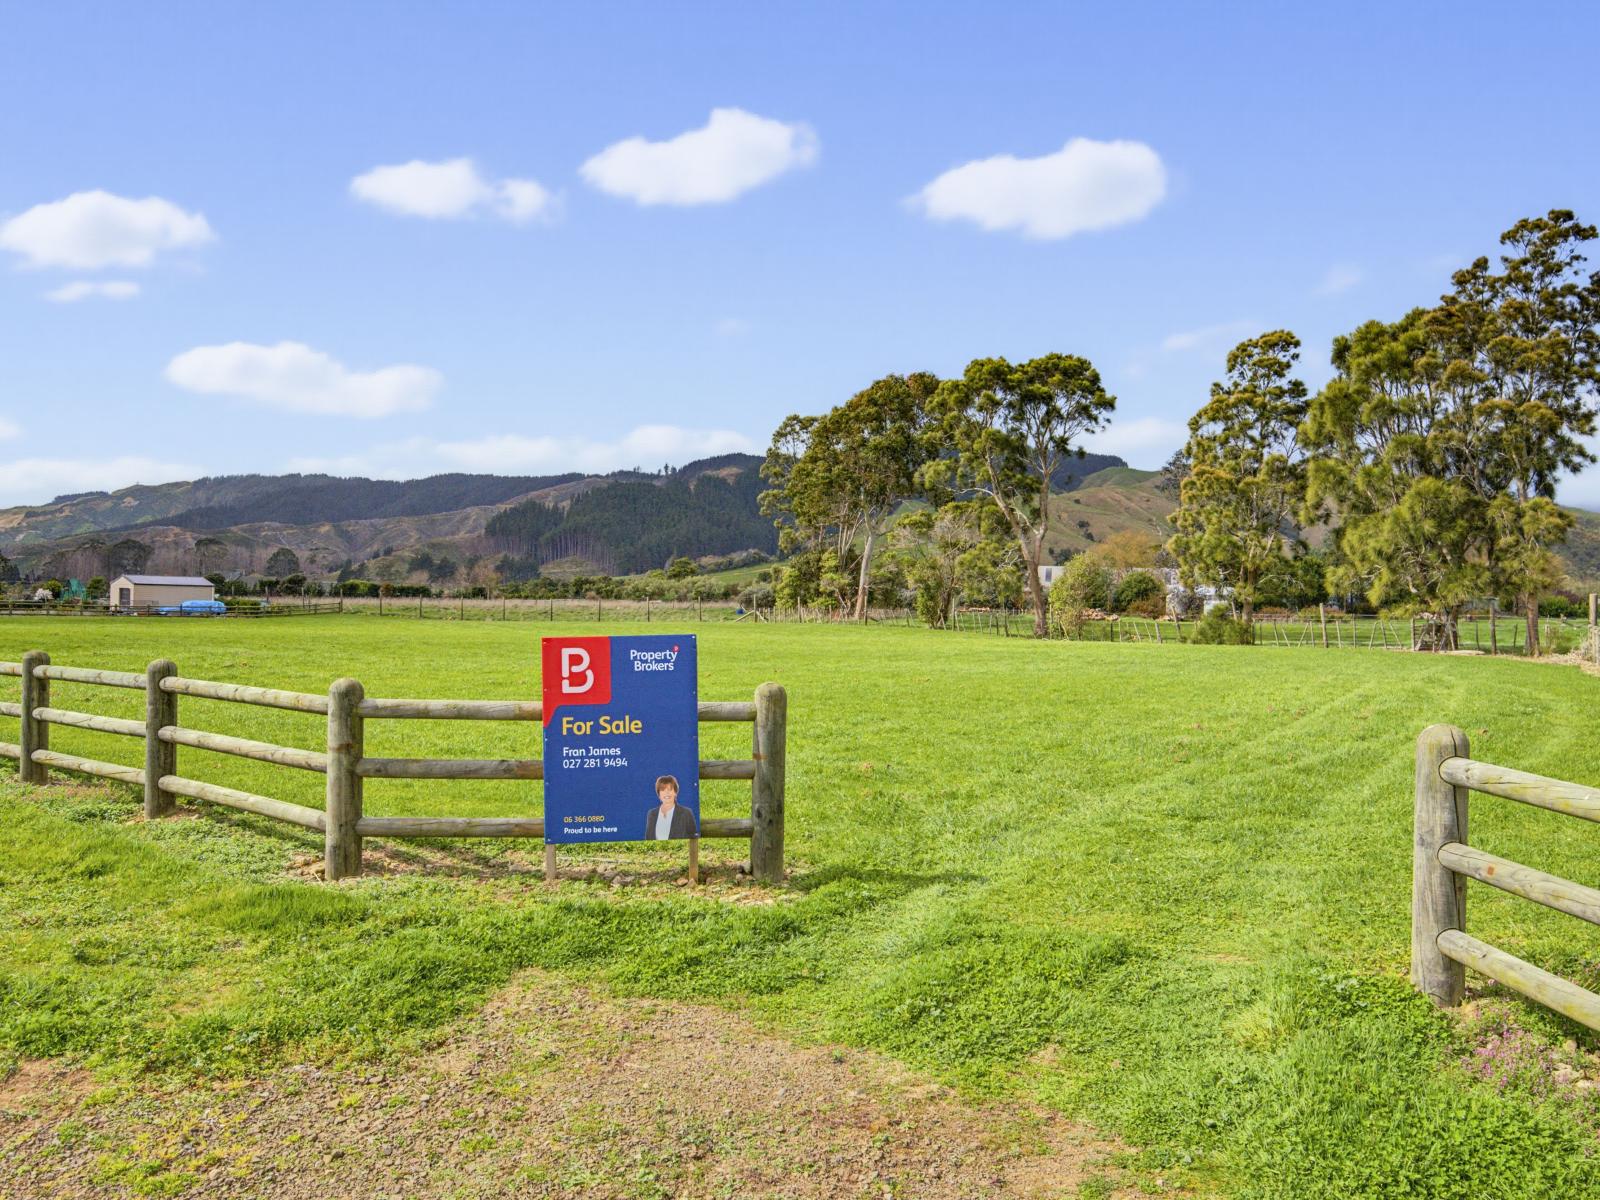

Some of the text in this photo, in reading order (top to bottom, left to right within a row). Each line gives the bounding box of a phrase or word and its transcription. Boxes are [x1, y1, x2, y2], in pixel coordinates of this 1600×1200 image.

[630, 649, 678, 662] Property
[561, 647, 594, 694] B
[634, 661, 674, 671] Brokers
[562, 715, 642, 736] For Sale
[563, 746, 621, 757] Fran James
[563, 758, 628, 769] 027 281 9494
[587, 815, 605, 823] 0880
